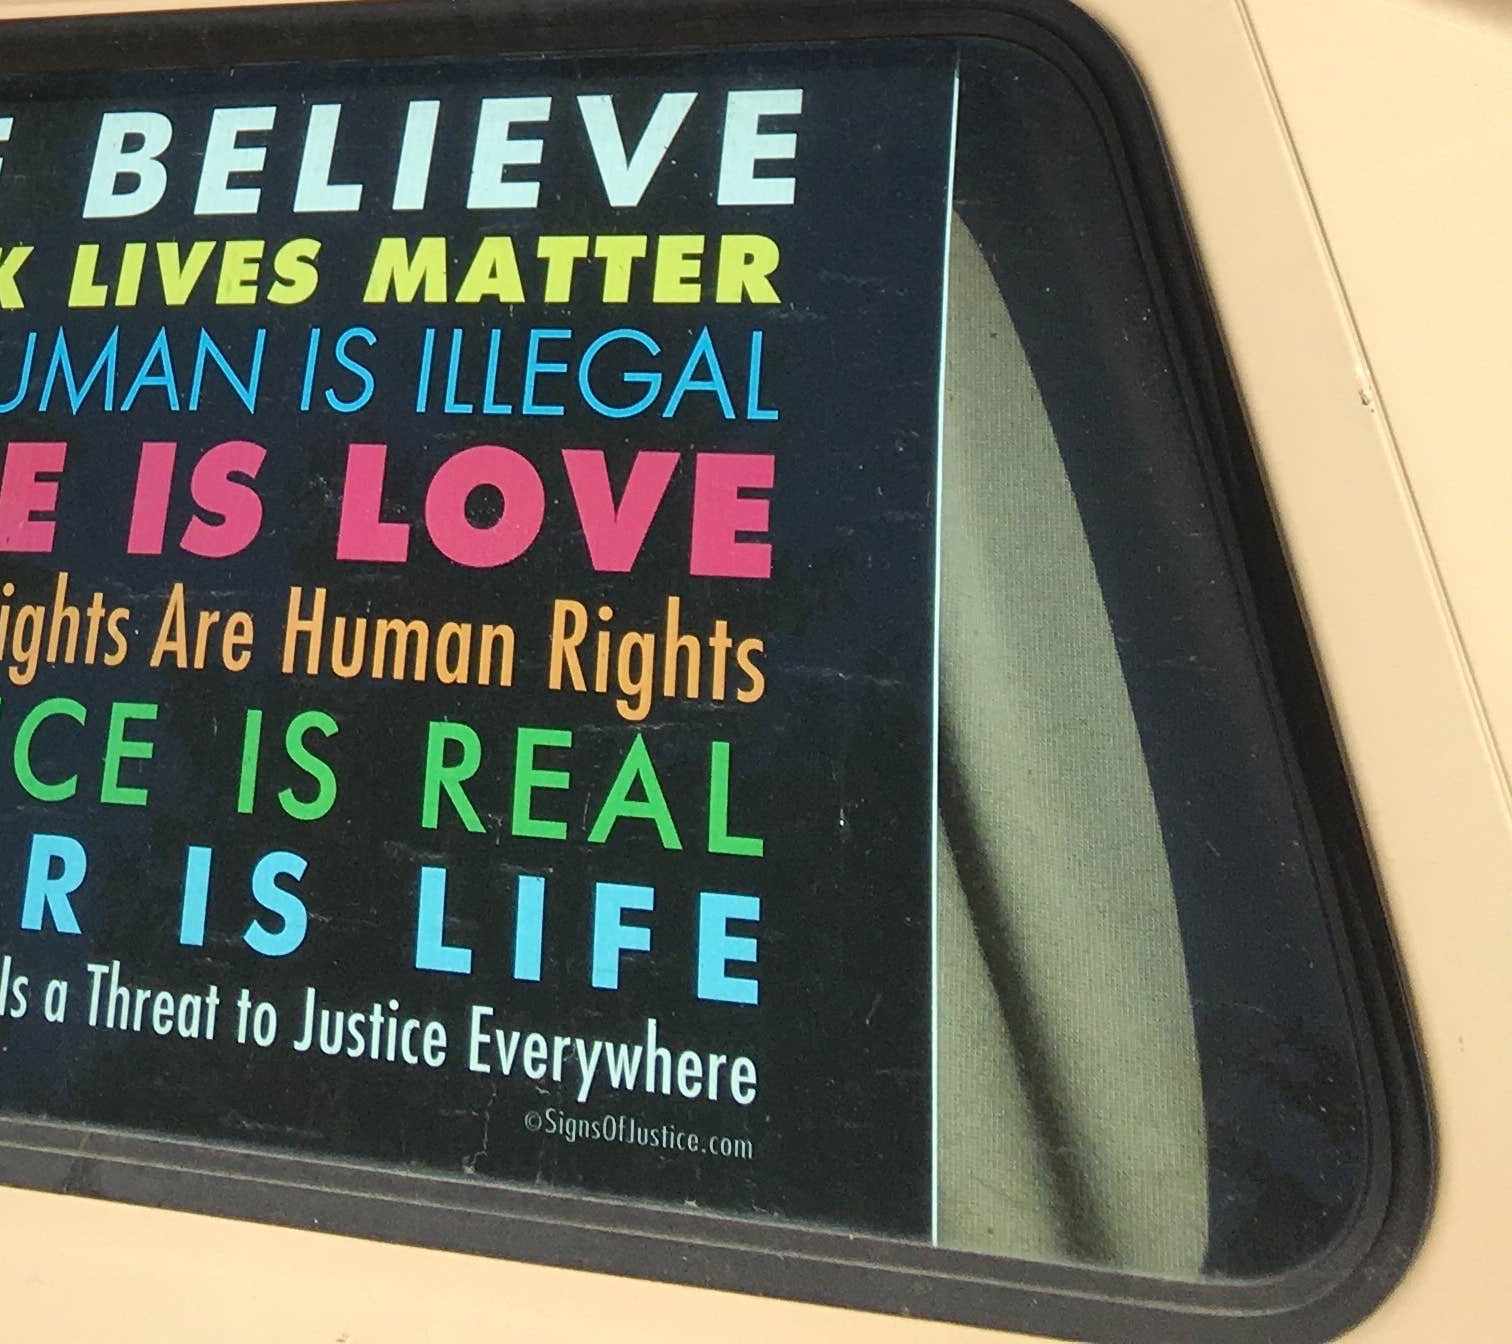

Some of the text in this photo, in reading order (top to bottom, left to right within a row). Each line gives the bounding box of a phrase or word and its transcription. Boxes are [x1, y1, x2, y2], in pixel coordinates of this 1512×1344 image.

[83, 89, 803, 218] BELIEVE
[68, 240, 321, 307] LIVES
[363, 235, 781, 303] MATTER
[301, 327, 376, 412] IS
[416, 326, 778, 420] ILLEGAL
[127, 441, 266, 557] IS
[337, 444, 775, 578] LOVE
[150, 582, 254, 673] Are
[282, 586, 515, 687] Human
[549, 596, 764, 720] Rights
[238, 708, 338, 821] IS
[422, 716, 763, 857] REAL
[180, 845, 307, 957] IS
[416, 867, 760, 1005] LIFE
[45, 979, 67, 1023] a
[87, 959, 220, 1039] Threat
[236, 988, 276, 1047] to
[293, 986, 447, 1068] Justice
[469, 1004, 756, 1105] Everywhere
